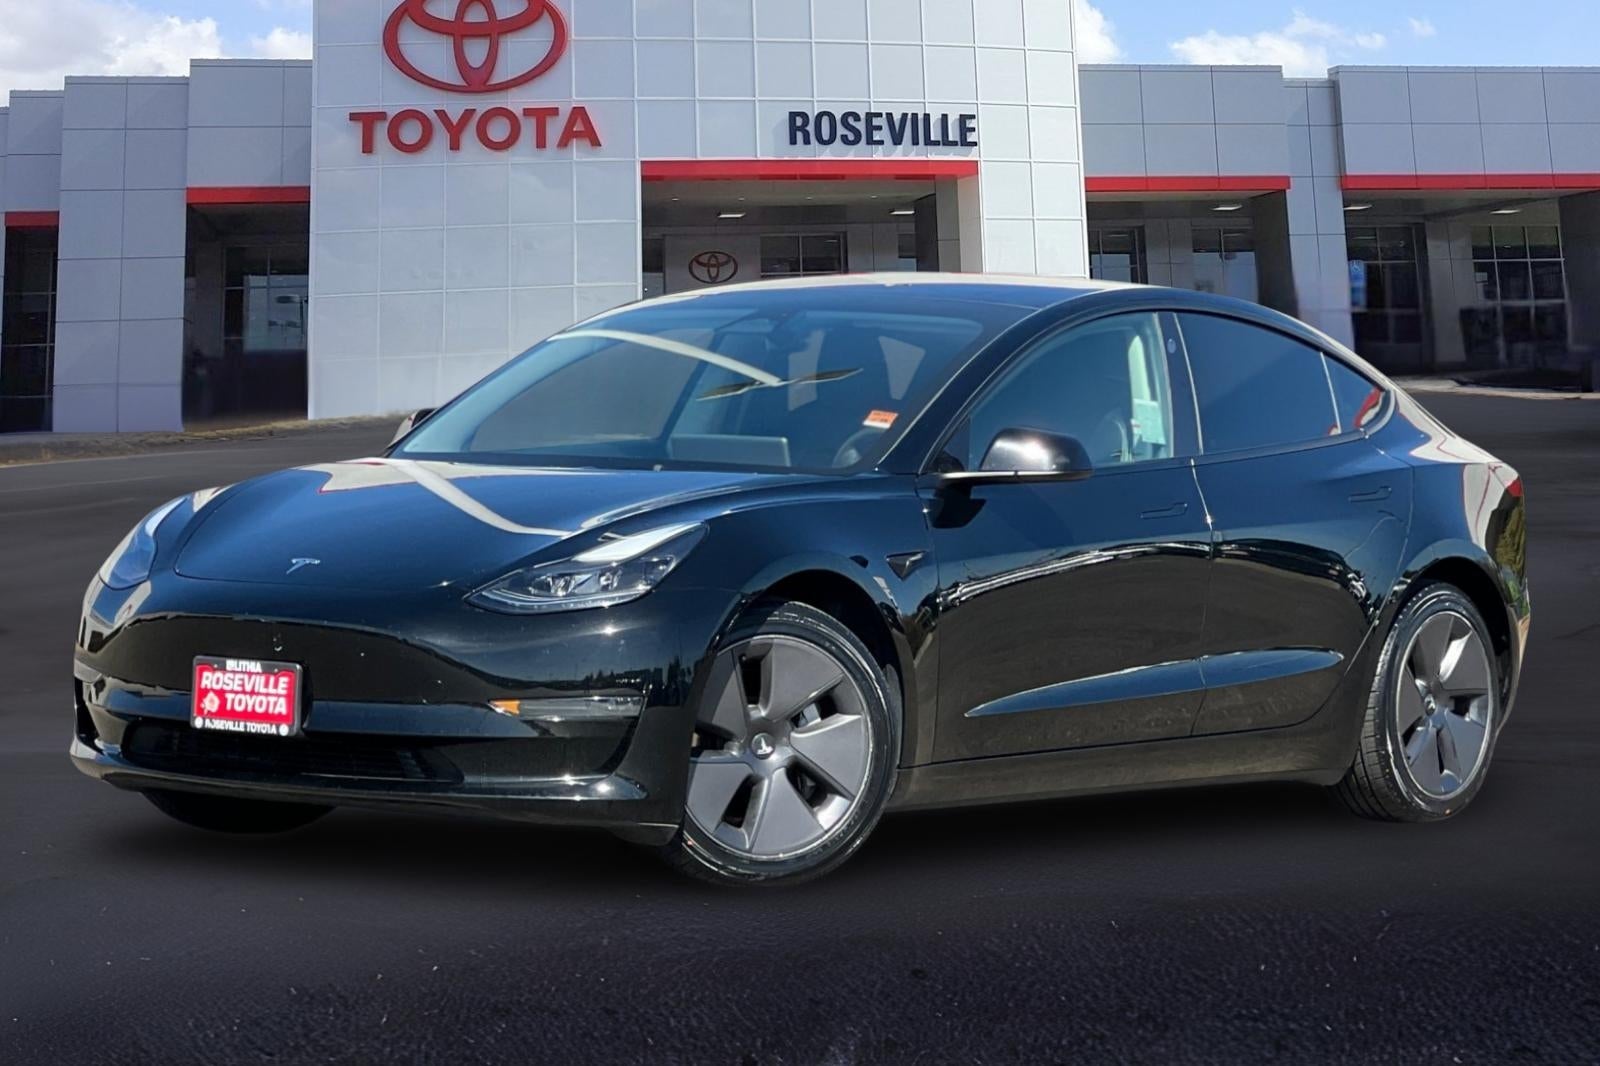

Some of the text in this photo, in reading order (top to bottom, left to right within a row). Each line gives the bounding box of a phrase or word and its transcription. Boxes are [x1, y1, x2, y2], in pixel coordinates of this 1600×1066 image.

[349, 106, 602, 154] TOYOTA
[788, 110, 978, 147] ROSEVILLE
[200, 671, 289, 695] ROSEVILLE
[225, 692, 287, 715] TOYOTA
[246, 721, 277, 735] TOYOTA
